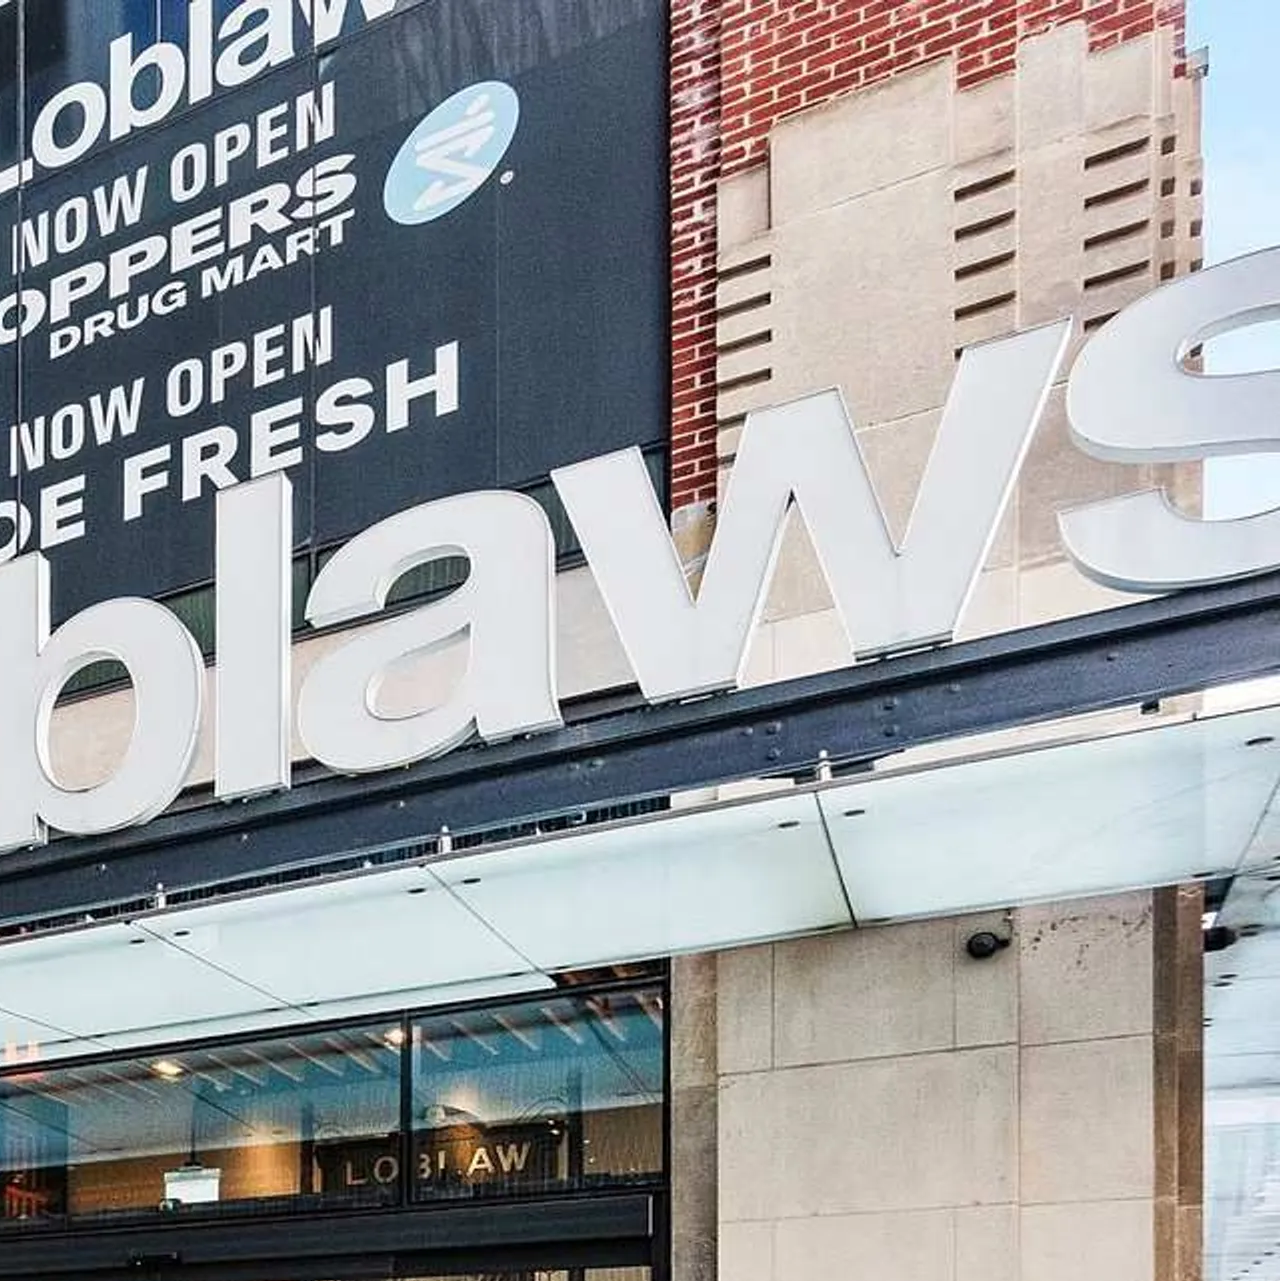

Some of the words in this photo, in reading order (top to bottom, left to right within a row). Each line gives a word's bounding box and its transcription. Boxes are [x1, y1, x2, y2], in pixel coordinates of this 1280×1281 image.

[12, 164, 146, 276] NOW
[170, 81, 336, 203] OPEN
[49, 281, 188, 360] DRUG
[201, 209, 356, 302] MART
[10, 377, 144, 478] NOW
[167, 304, 334, 419] OPEN
[123, 340, 461, 523] FRESH
